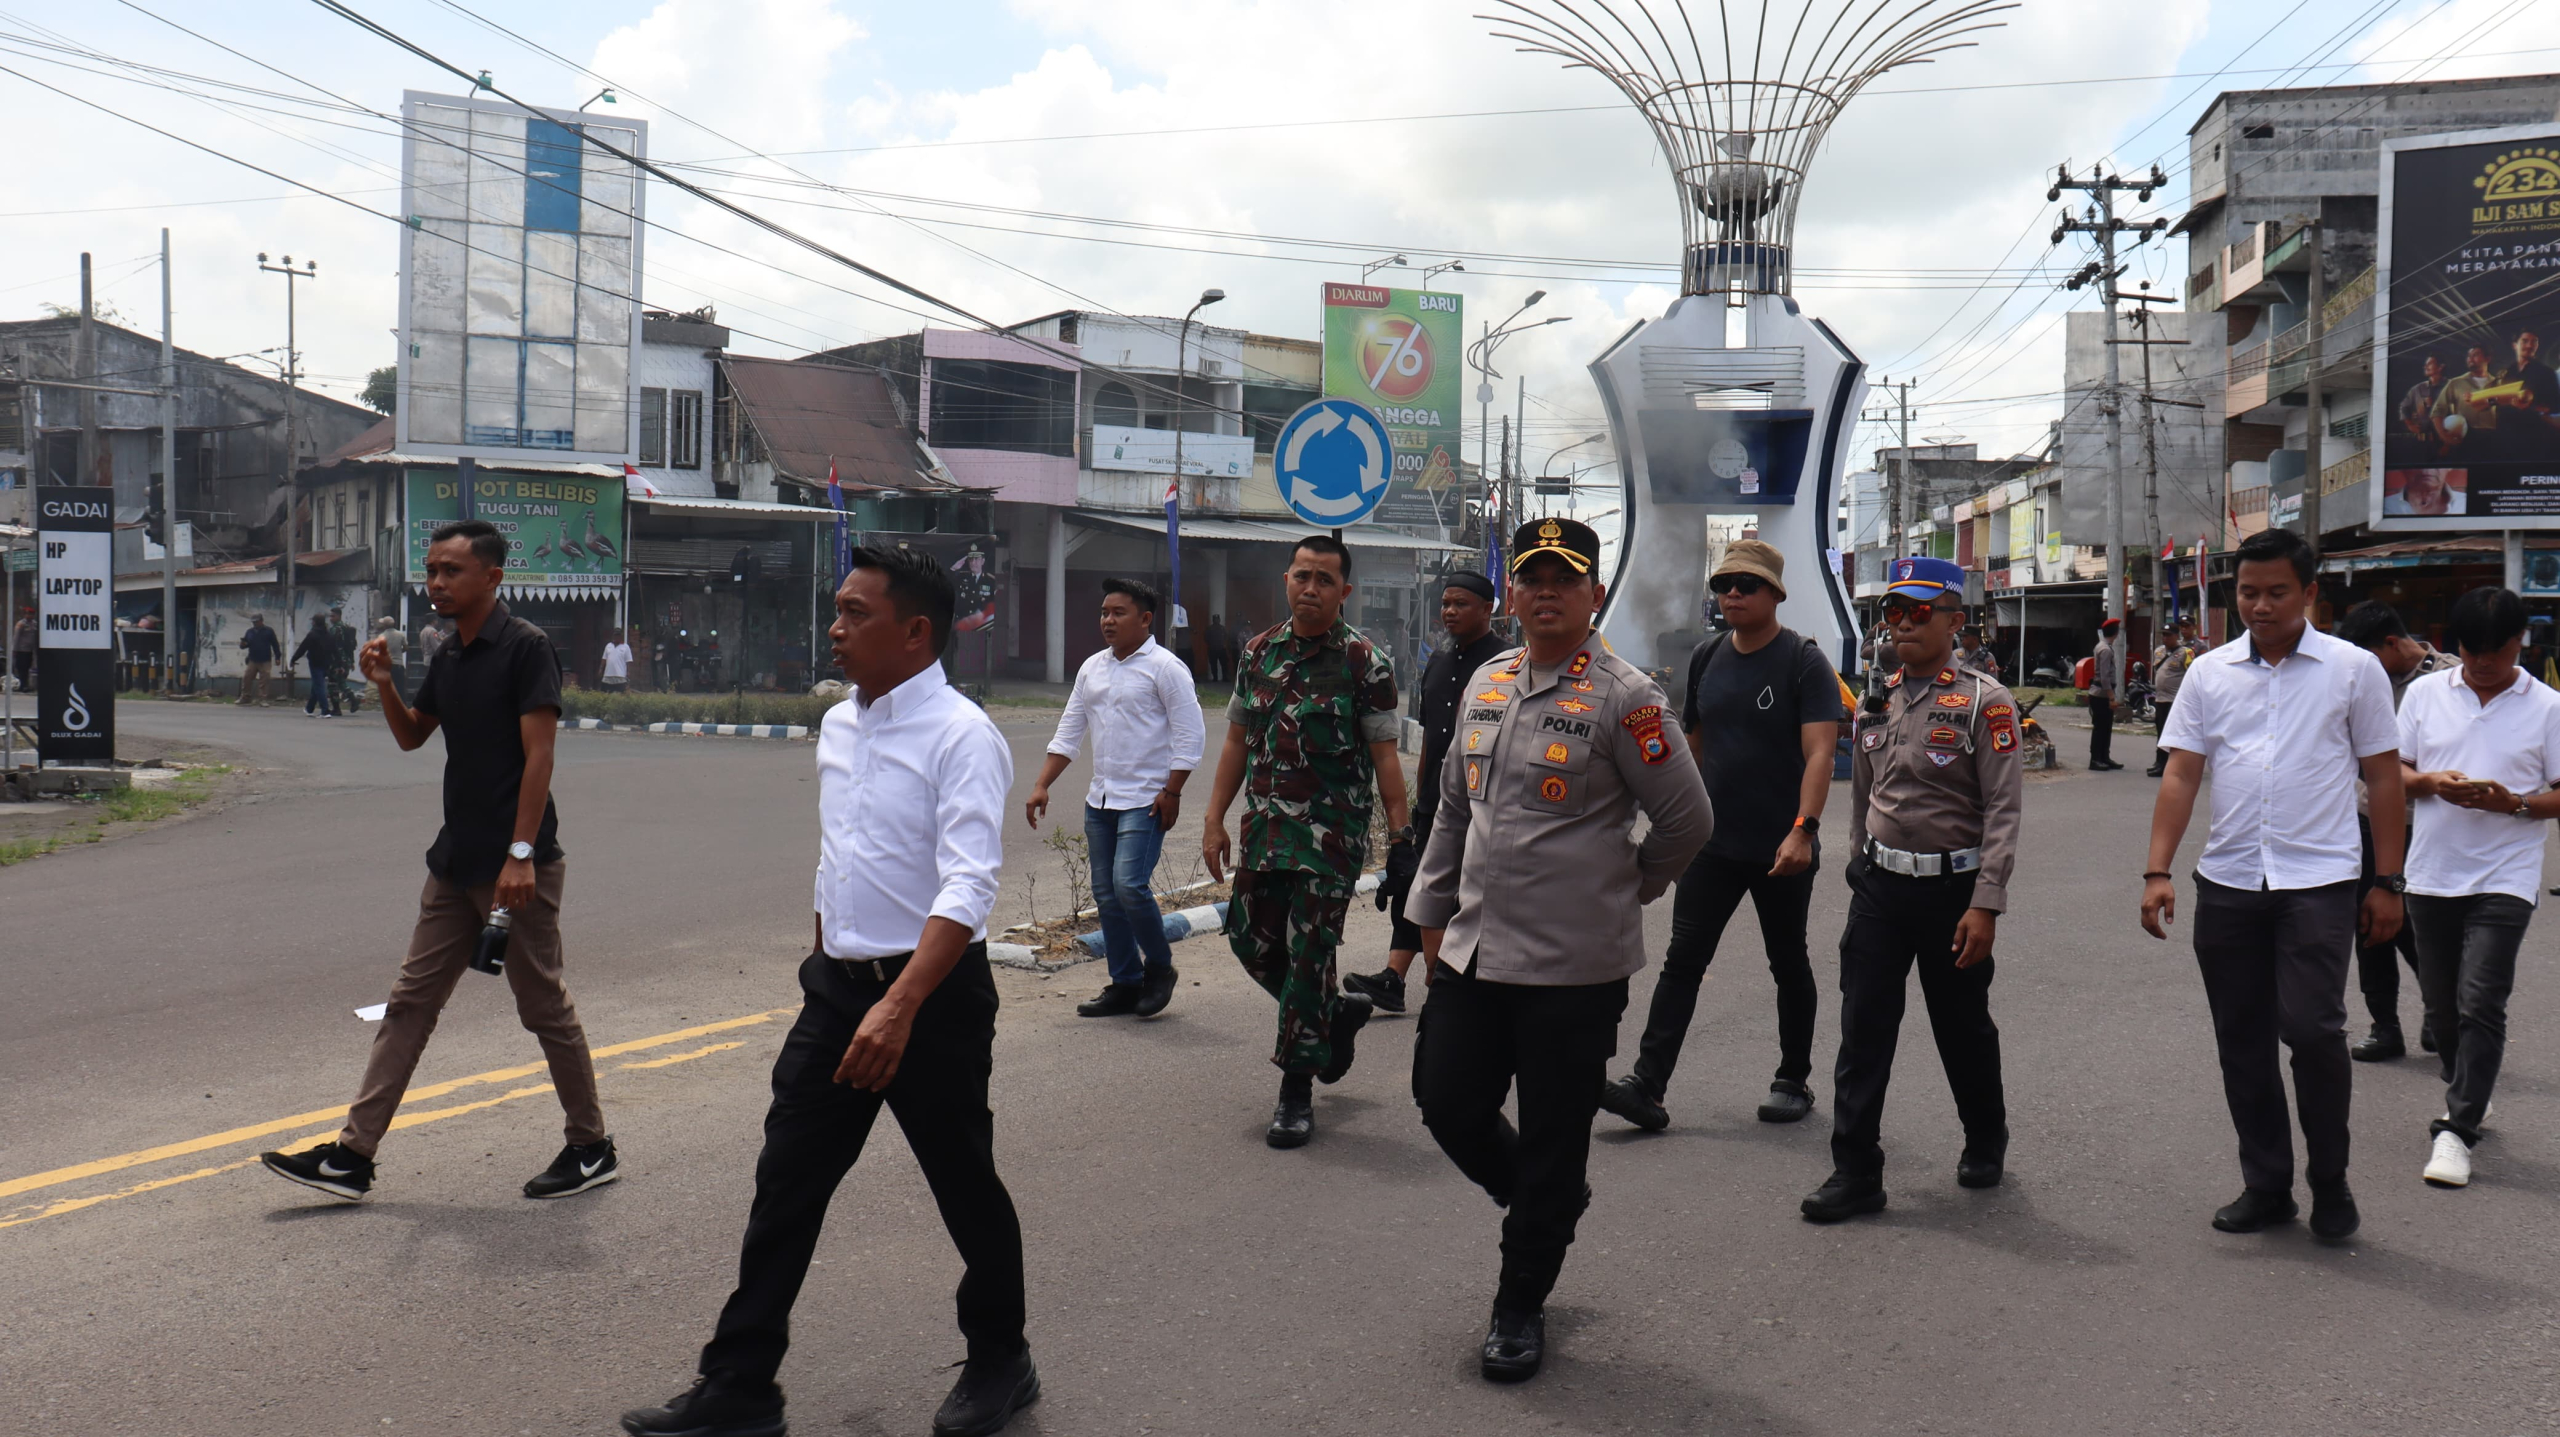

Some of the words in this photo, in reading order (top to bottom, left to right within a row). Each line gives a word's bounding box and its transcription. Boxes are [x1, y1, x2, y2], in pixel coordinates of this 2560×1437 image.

[2495, 168, 2558, 193] 234
[2506, 202, 2544, 220] SAM
[2462, 247, 2504, 258] KITA
[2446, 258, 2560, 273] MERAYAKAN
[1332, 288, 1384, 302] DJARUM
[1419, 295, 1457, 313] BARU
[1369, 322, 1423, 391] 76
[1374, 406, 1442, 426] ANGGA
[1395, 432, 1424, 445] YAL
[2520, 476, 2560, 485] PERIN
[516, 481, 598, 504] BELIBIS
[43, 501, 108, 518] GADAI
[478, 502, 519, 515] TUGU
[524, 504, 559, 516] TANI
[46, 542, 67, 559] HP
[46, 578, 103, 595] LAPTOP
[46, 614, 100, 631] MOTOR
[1624, 707, 1658, 725] POLRES
[1927, 712, 1968, 726] POLRI
[1542, 716, 1591, 738] POLRI
